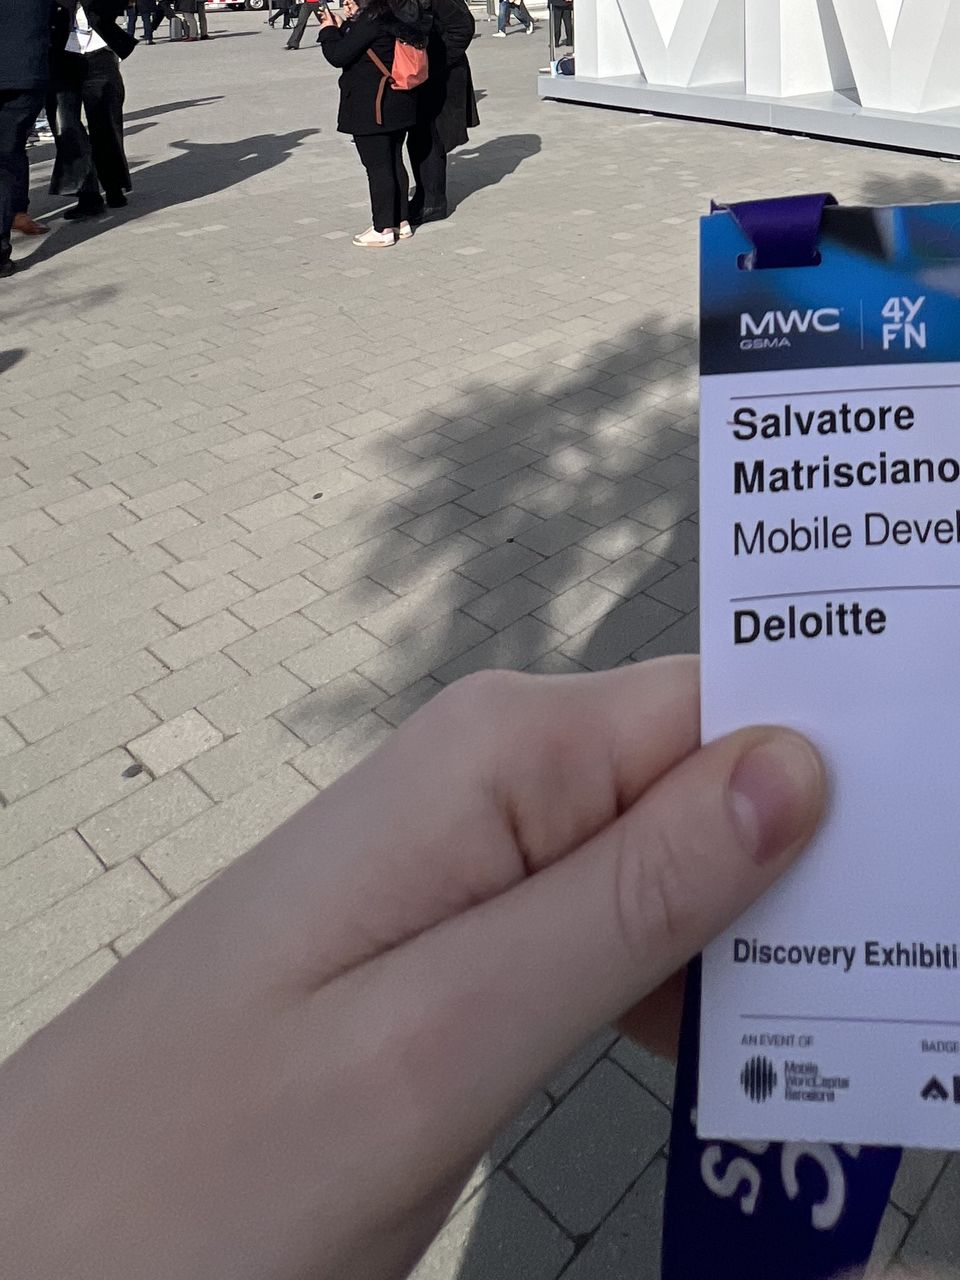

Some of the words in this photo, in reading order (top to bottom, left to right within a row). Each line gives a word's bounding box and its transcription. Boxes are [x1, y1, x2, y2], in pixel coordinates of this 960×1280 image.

[739, 307, 840, 337] MWC
[739, 336, 792, 351] GSMA
[732, 403, 915, 441] Salvatore
[733, 451, 960, 495] Matrisciano
[733, 516, 853, 556] Mobile
[733, 601, 887, 645] Deloitte
[733, 937, 856, 973] Discovery
[740, 1033, 758, 1047] AN
[759, 1033, 796, 1048] EVENT
[797, 1034, 815, 1049] OF
[920, 1039, 960, 1055] BADGE
